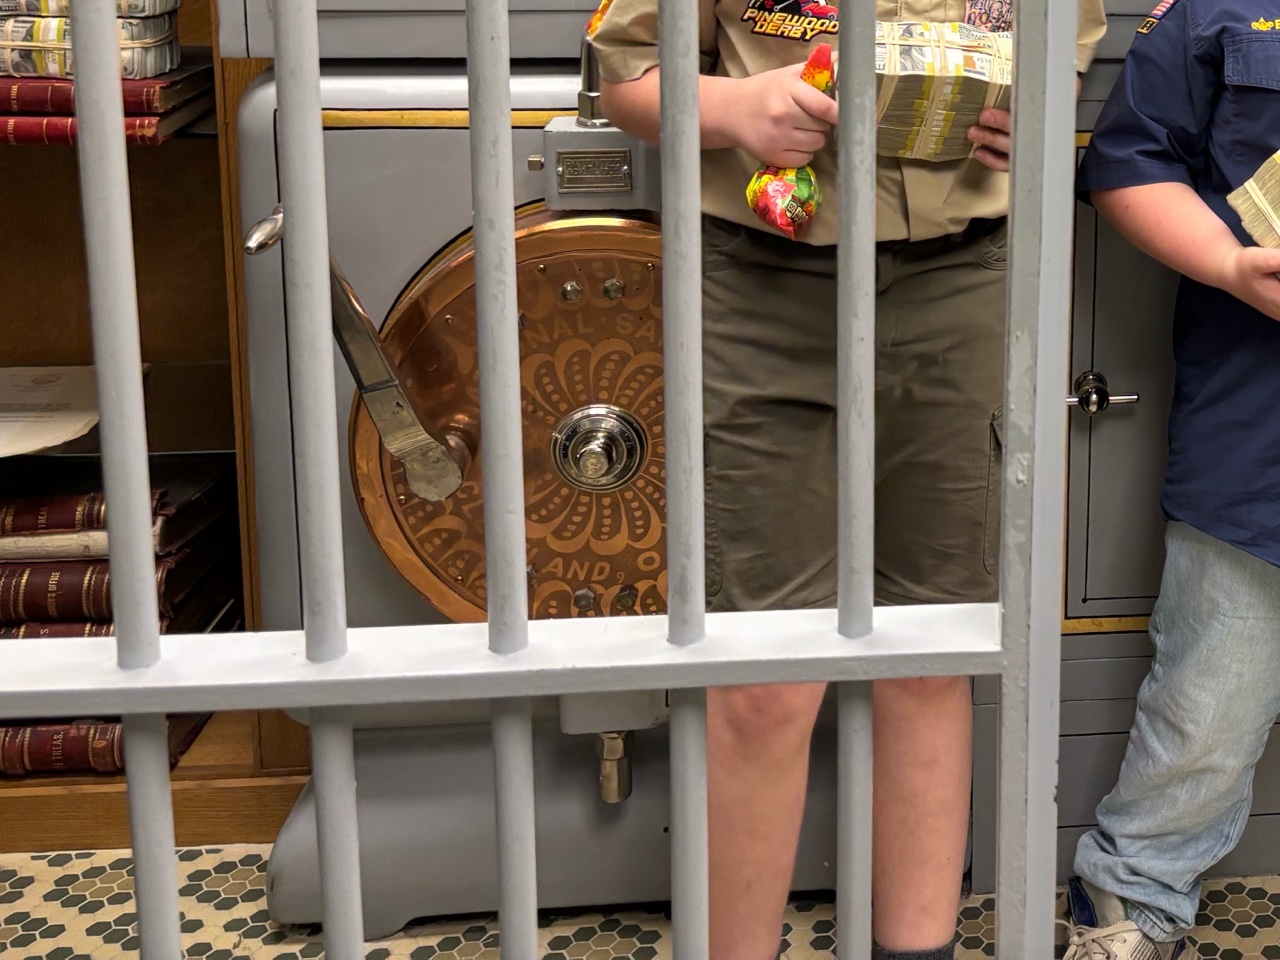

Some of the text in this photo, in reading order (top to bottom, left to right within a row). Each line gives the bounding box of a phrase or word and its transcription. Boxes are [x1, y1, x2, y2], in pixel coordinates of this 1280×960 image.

[744, 7, 839, 33] PINEWOOD
[755, 21, 818, 39] DERBY
[47, 571, 61, 591] OFFICE
[51, 731, 64, 761] TREAS.
